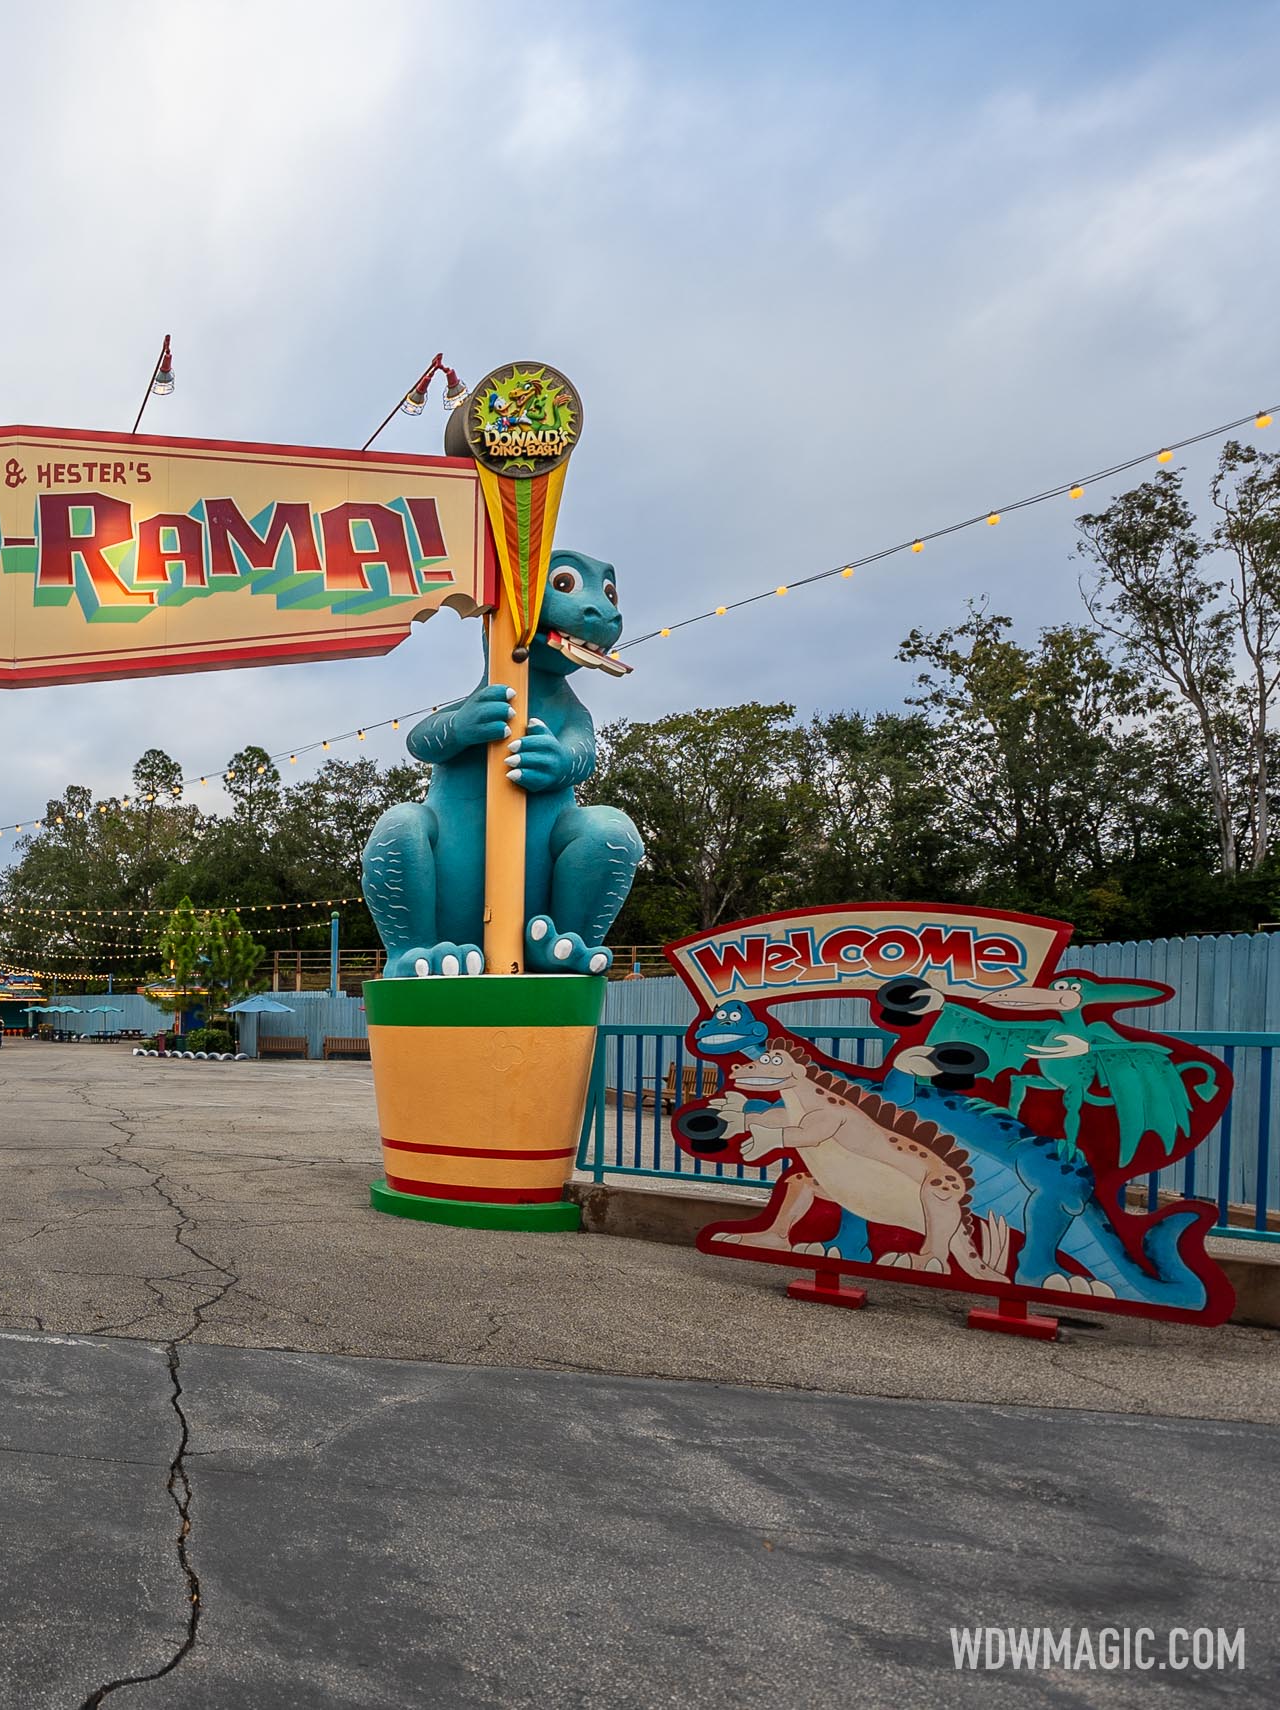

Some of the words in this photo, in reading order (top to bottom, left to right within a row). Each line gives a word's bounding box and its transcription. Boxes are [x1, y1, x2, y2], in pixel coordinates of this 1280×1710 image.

[484, 427, 568, 448] DONALD'S
[4, 457, 28, 489] &
[37, 461, 152, 488] HESTER'S
